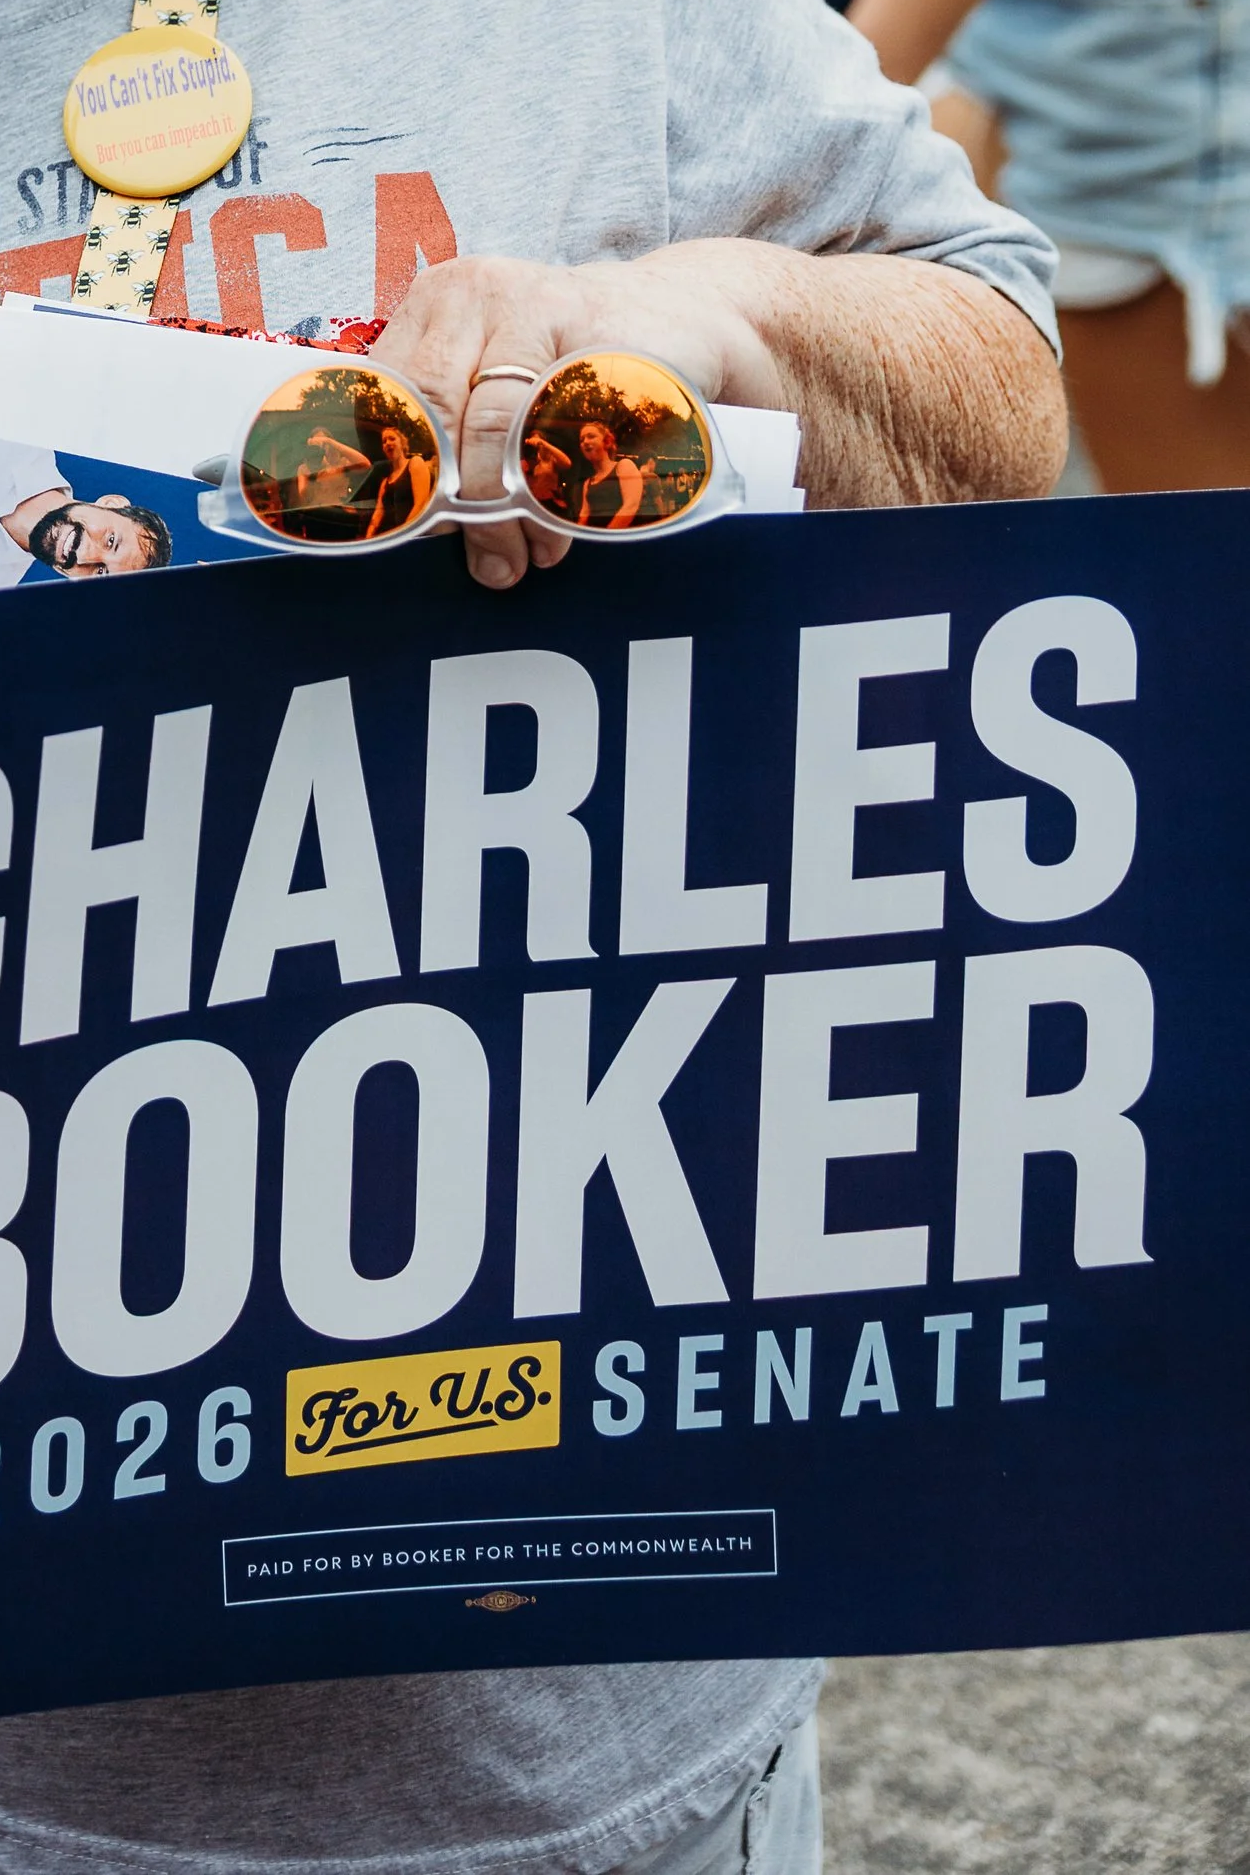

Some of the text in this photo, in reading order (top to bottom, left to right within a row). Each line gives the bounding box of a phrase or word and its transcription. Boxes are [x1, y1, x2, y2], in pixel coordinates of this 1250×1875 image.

[76, 47, 236, 117] You Can't Fix Stupid.
[96, 114, 237, 166] But you can impeach it.
[294, 1387, 419, 1456] For
[430, 1356, 552, 1421] U.S.
[593, 1304, 1048, 1436] SENATE
[248, 1536, 752, 1578] PAID FOR BY BOOKER FOR THE COMMONWEALTH
